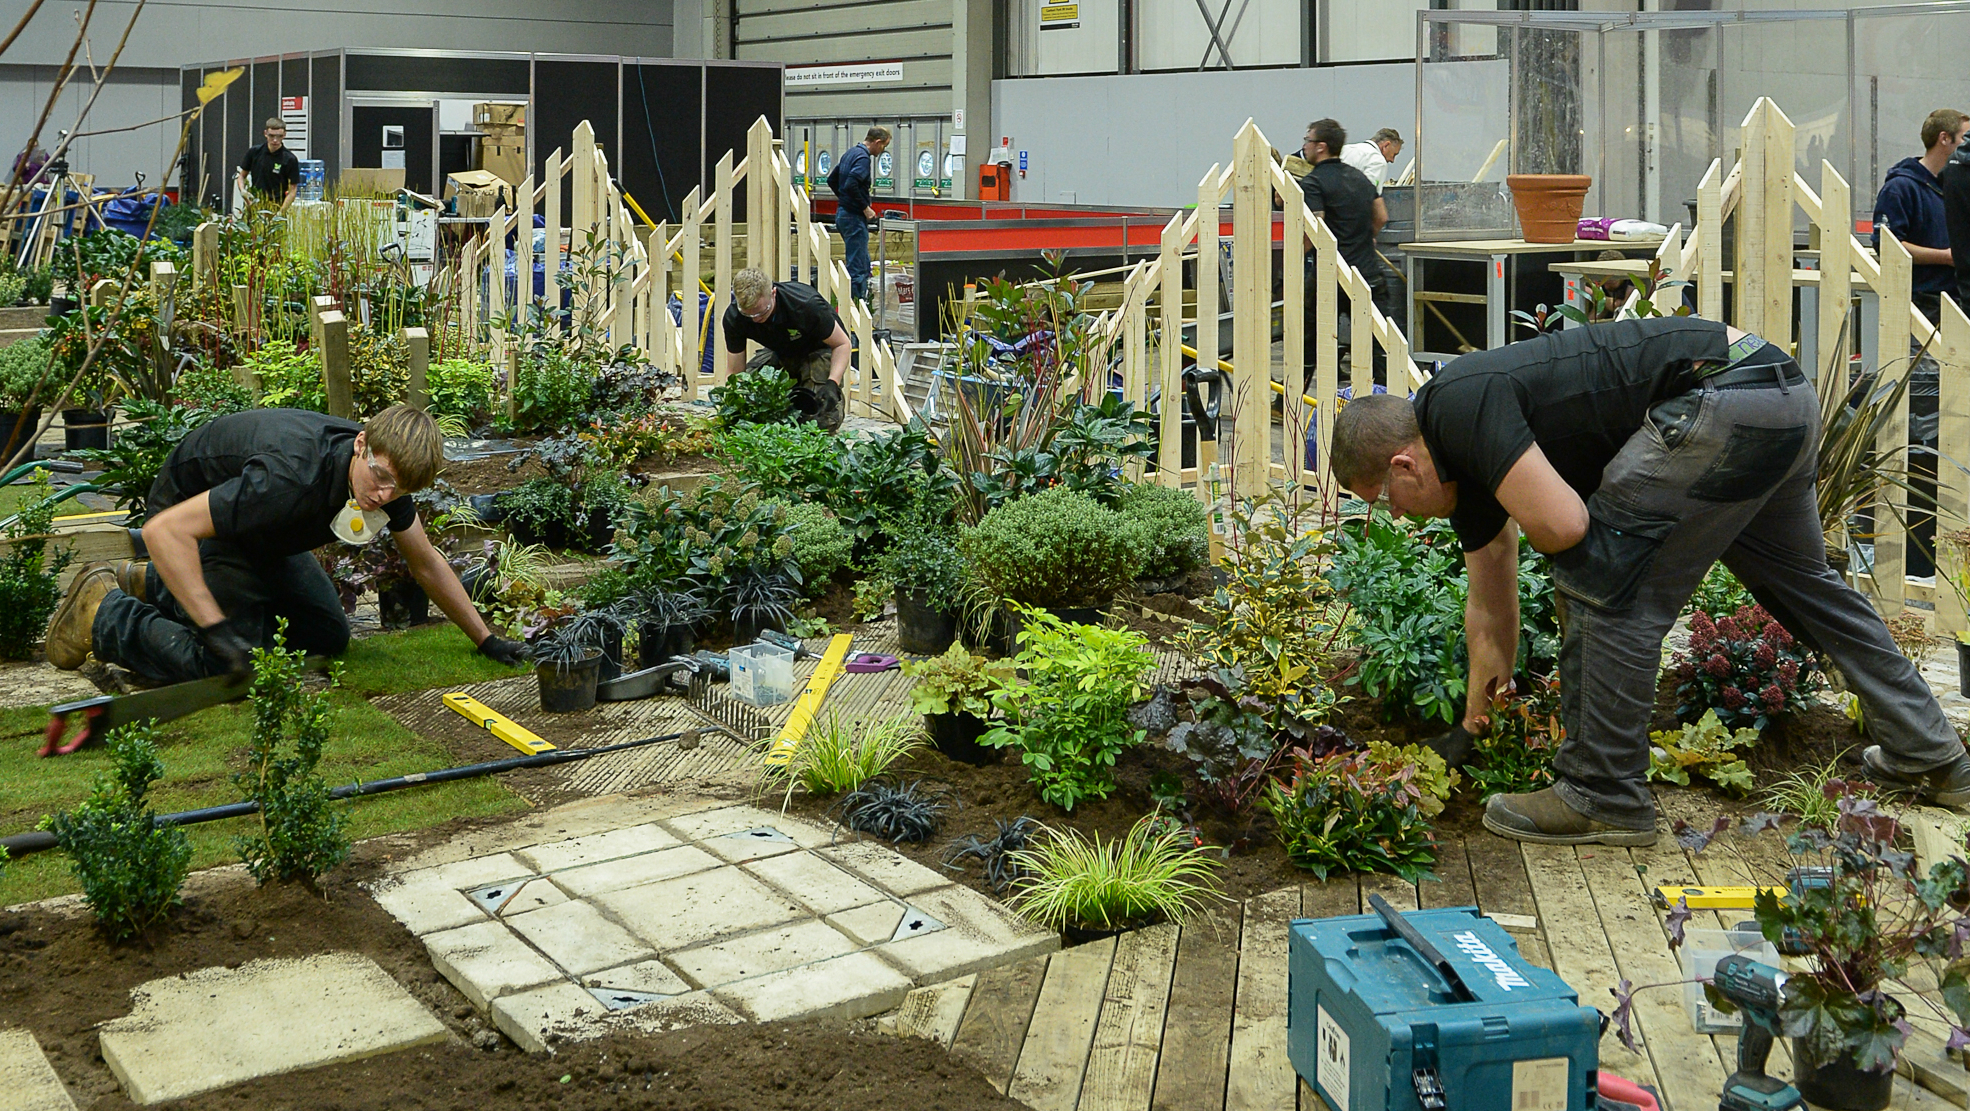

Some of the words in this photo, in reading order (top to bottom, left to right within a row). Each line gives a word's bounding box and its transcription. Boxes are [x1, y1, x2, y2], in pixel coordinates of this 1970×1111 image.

[823, 71, 834, 79] front
[849, 70, 874, 79] emergency
[875, 69, 885, 77] exit
